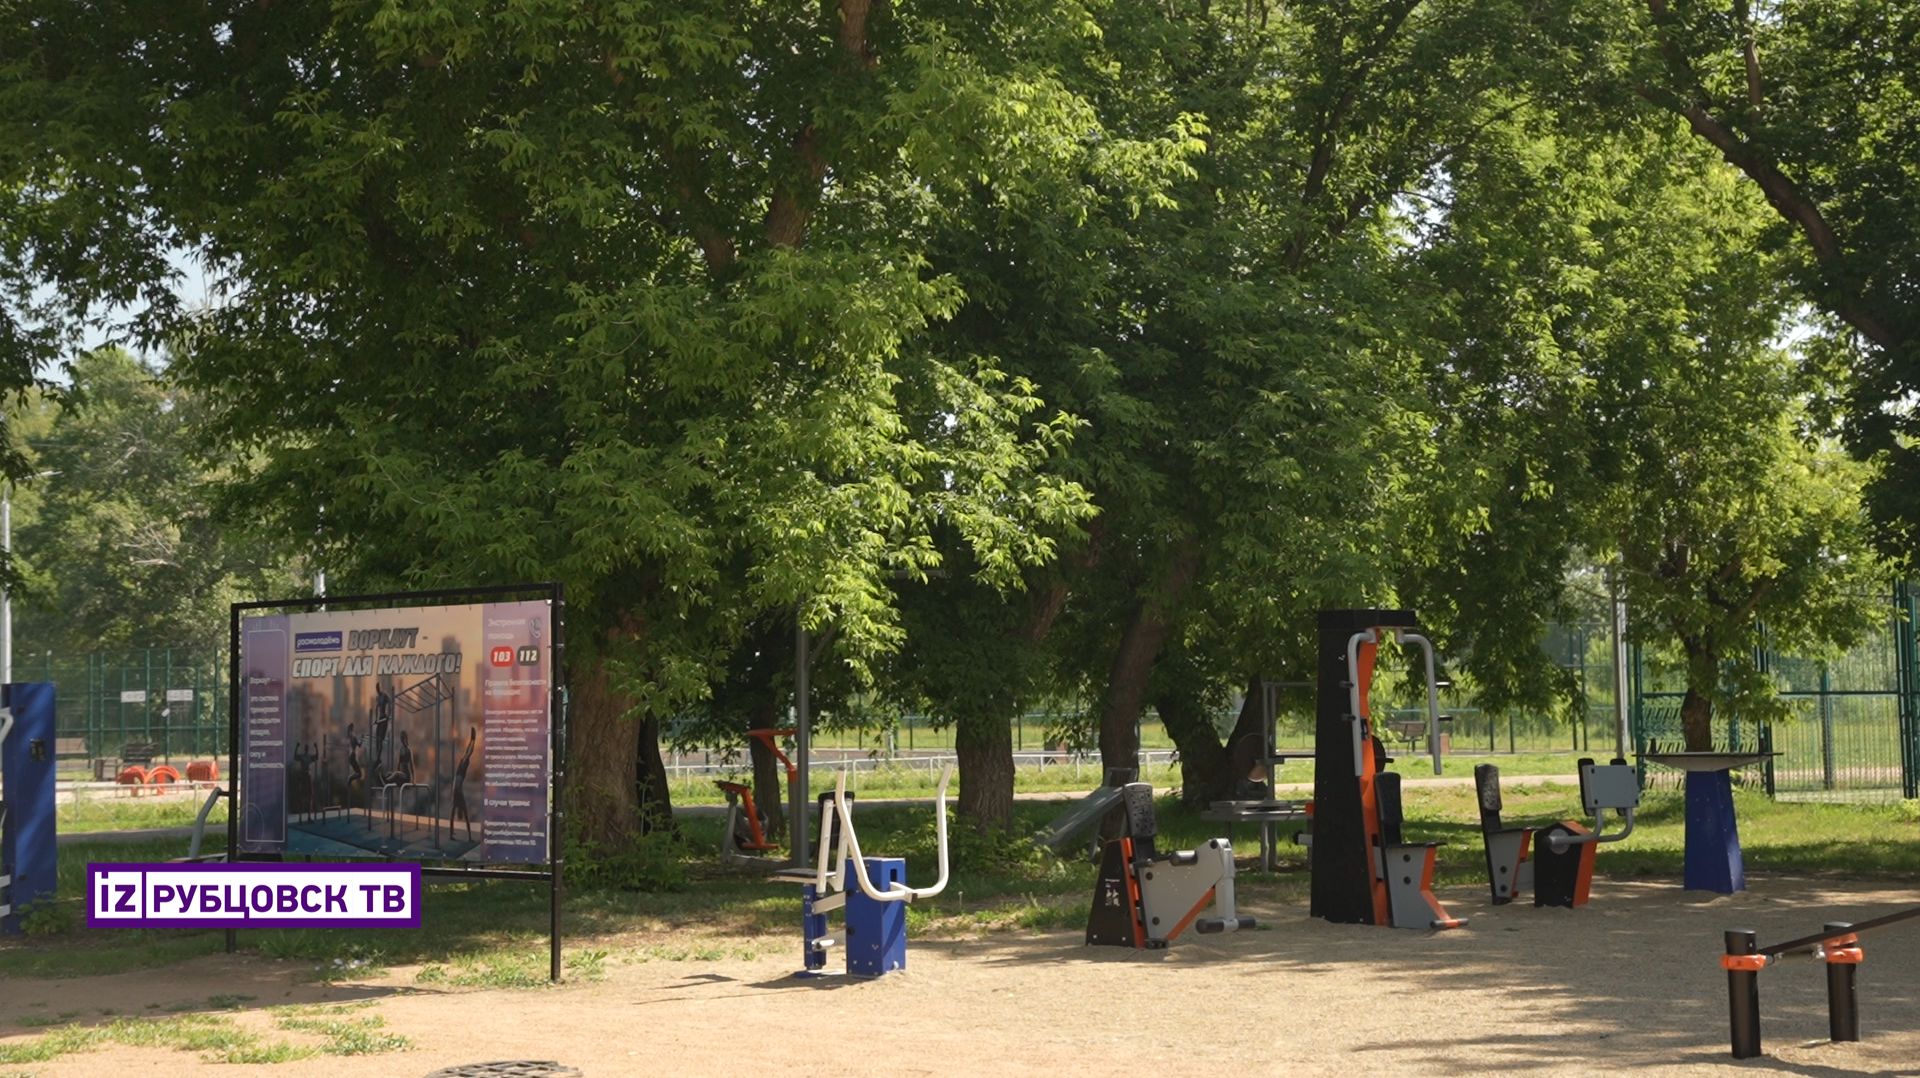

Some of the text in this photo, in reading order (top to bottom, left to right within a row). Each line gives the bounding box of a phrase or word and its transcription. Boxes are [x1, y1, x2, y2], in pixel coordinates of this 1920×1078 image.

[348, 627, 419, 651] ВОРКАУТ
[292, 652, 463, 678] СПОРТ ДЛЯ КАЖДОГО!
[493, 650, 538, 662] 103 112
